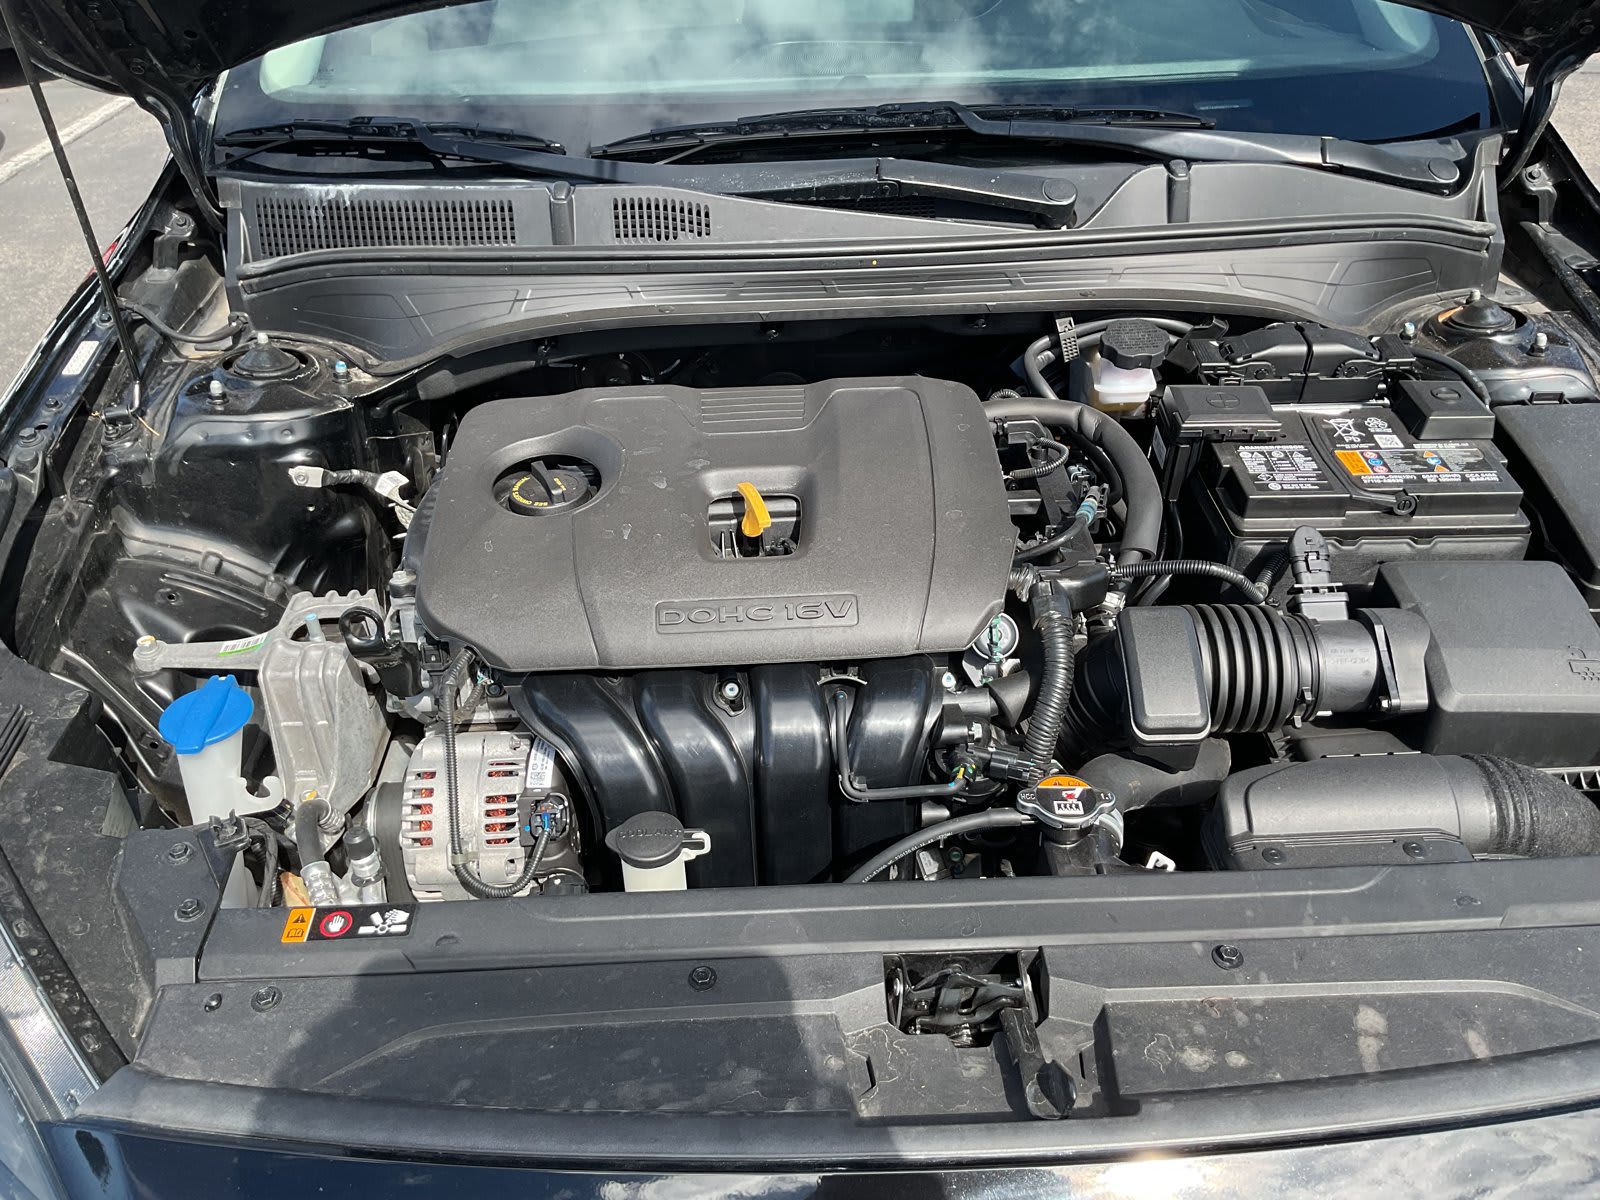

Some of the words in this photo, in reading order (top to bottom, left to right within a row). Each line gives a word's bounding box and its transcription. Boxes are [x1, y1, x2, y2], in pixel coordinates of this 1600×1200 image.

[1343, 435, 1361, 443] Pb
[658, 604, 774, 626] DOHC
[784, 600, 853, 623] 16V
[1100, 792, 1112, 800] 1.1
[618, 828, 682, 838] COOLANT
